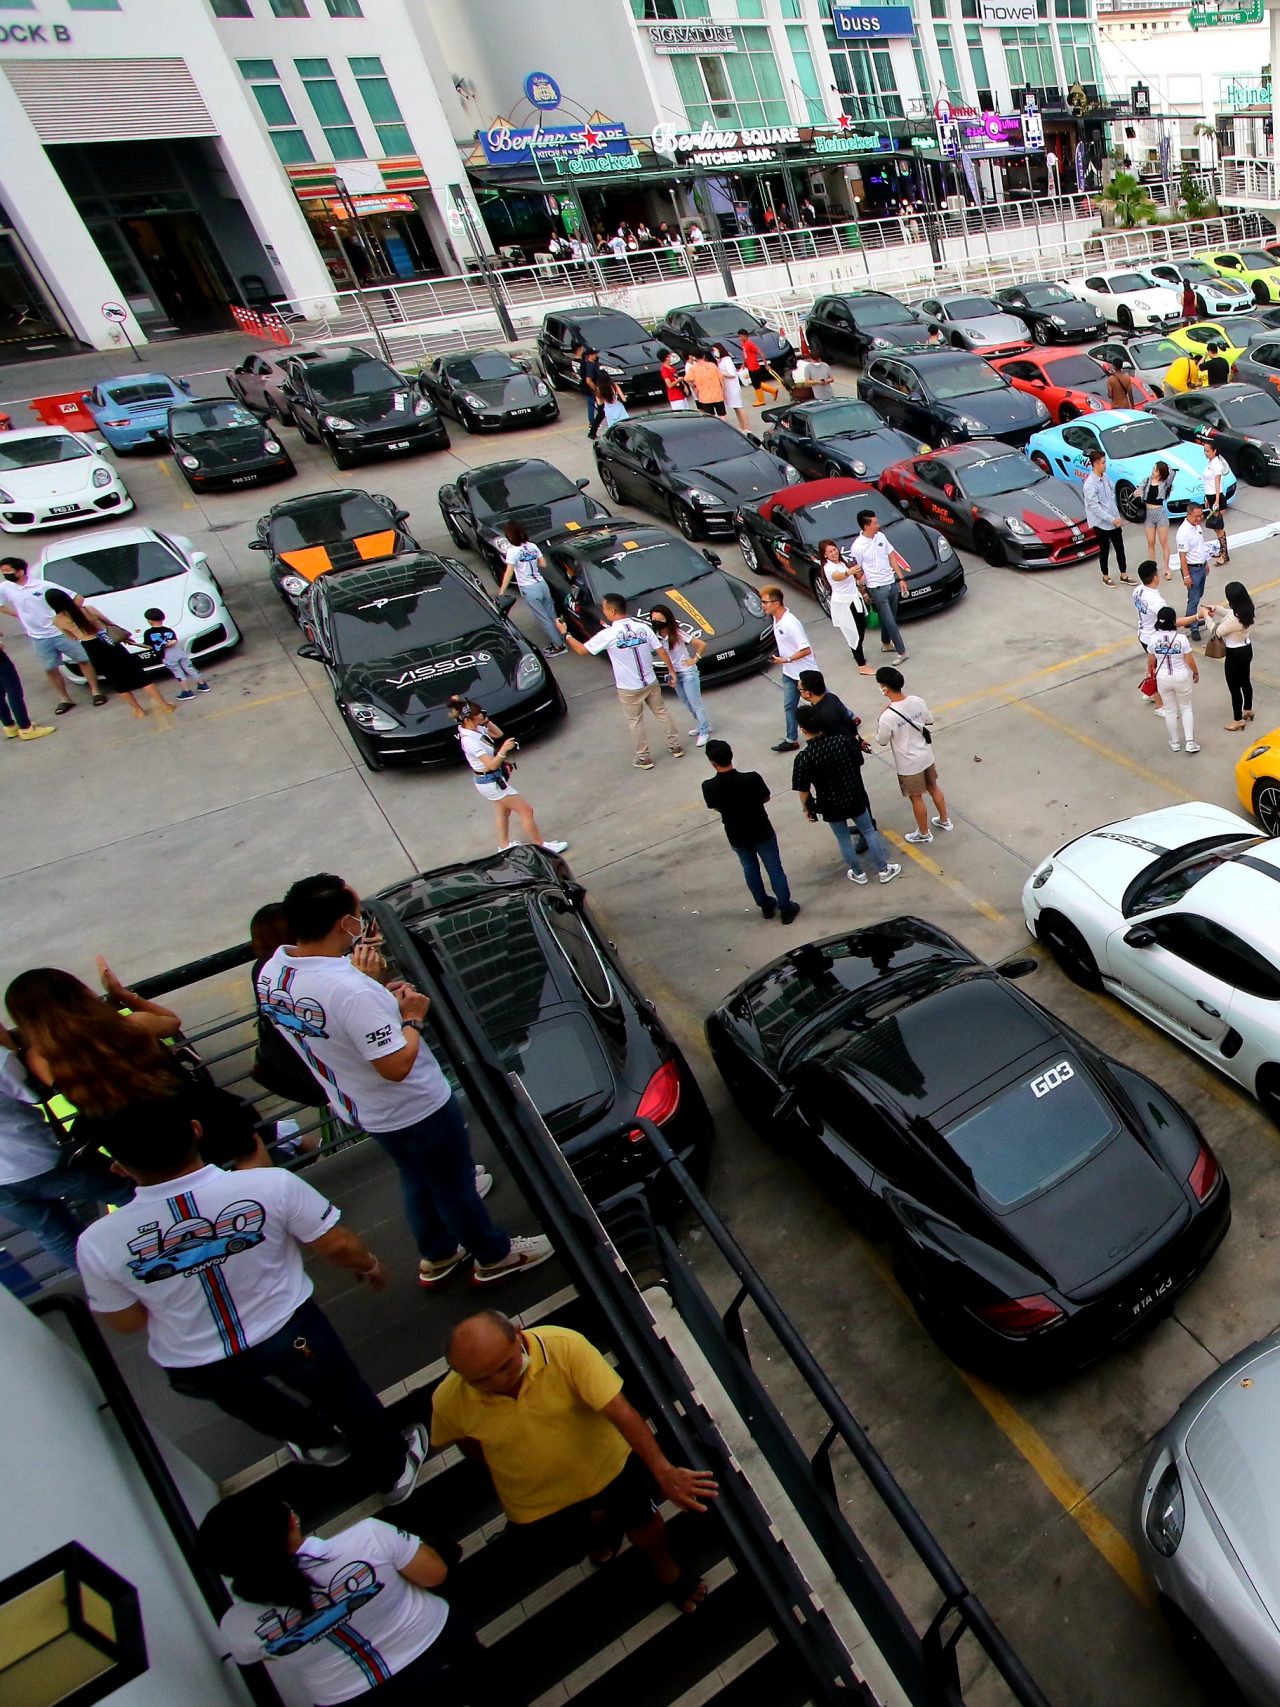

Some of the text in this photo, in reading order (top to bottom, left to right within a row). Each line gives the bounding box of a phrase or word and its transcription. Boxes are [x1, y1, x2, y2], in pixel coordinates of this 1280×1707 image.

[983, 4, 1036, 20] howei
[840, 13, 881, 31] buss
[53, 24, 72, 42] B
[649, 27, 735, 43] SIGNATURE
[570, 128, 623, 144] SARE
[741, 127, 801, 147] SQUARE
[814, 131, 881, 153] Heineken
[694, 148, 773, 166] KITCHEN BAR
[931, 504, 949, 517] RACE
[1099, 832, 1158, 850] PORSCHE
[365, 1024, 393, 1045] 352
[1030, 1061, 1075, 1098] G03
[127, 1199, 266, 1260] 100
[138, 1221, 159, 1234] THE
[183, 1256, 227, 1278] CONVOY
[312, 1614, 351, 1645] CONVOY
